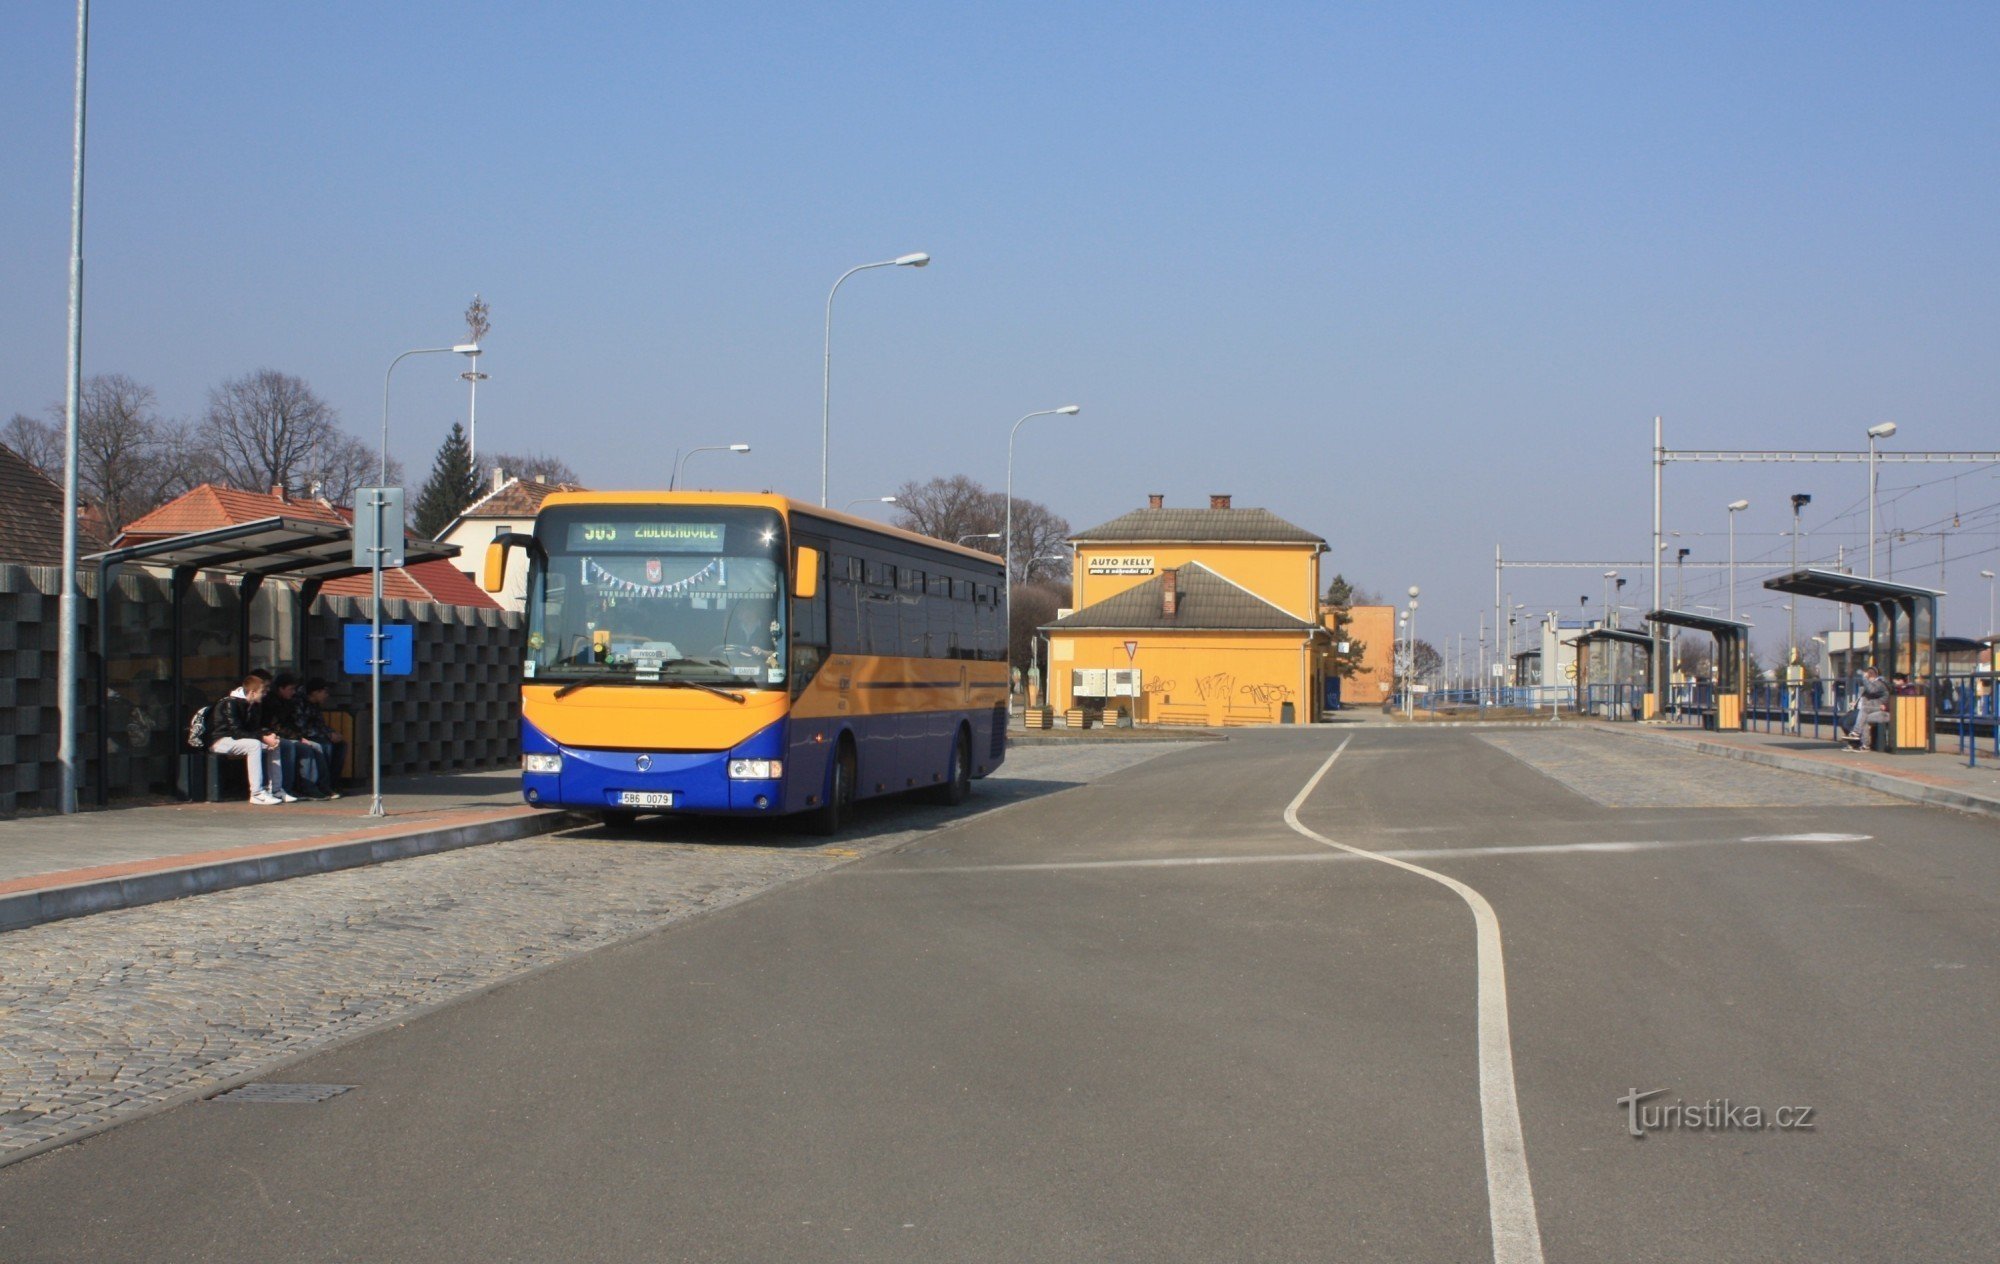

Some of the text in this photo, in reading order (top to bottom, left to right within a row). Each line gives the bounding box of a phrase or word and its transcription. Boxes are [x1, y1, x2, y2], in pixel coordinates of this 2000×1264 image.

[1091, 558, 1152, 566] AUTO KELLY
[624, 793, 669, 804] 5B6 0079
